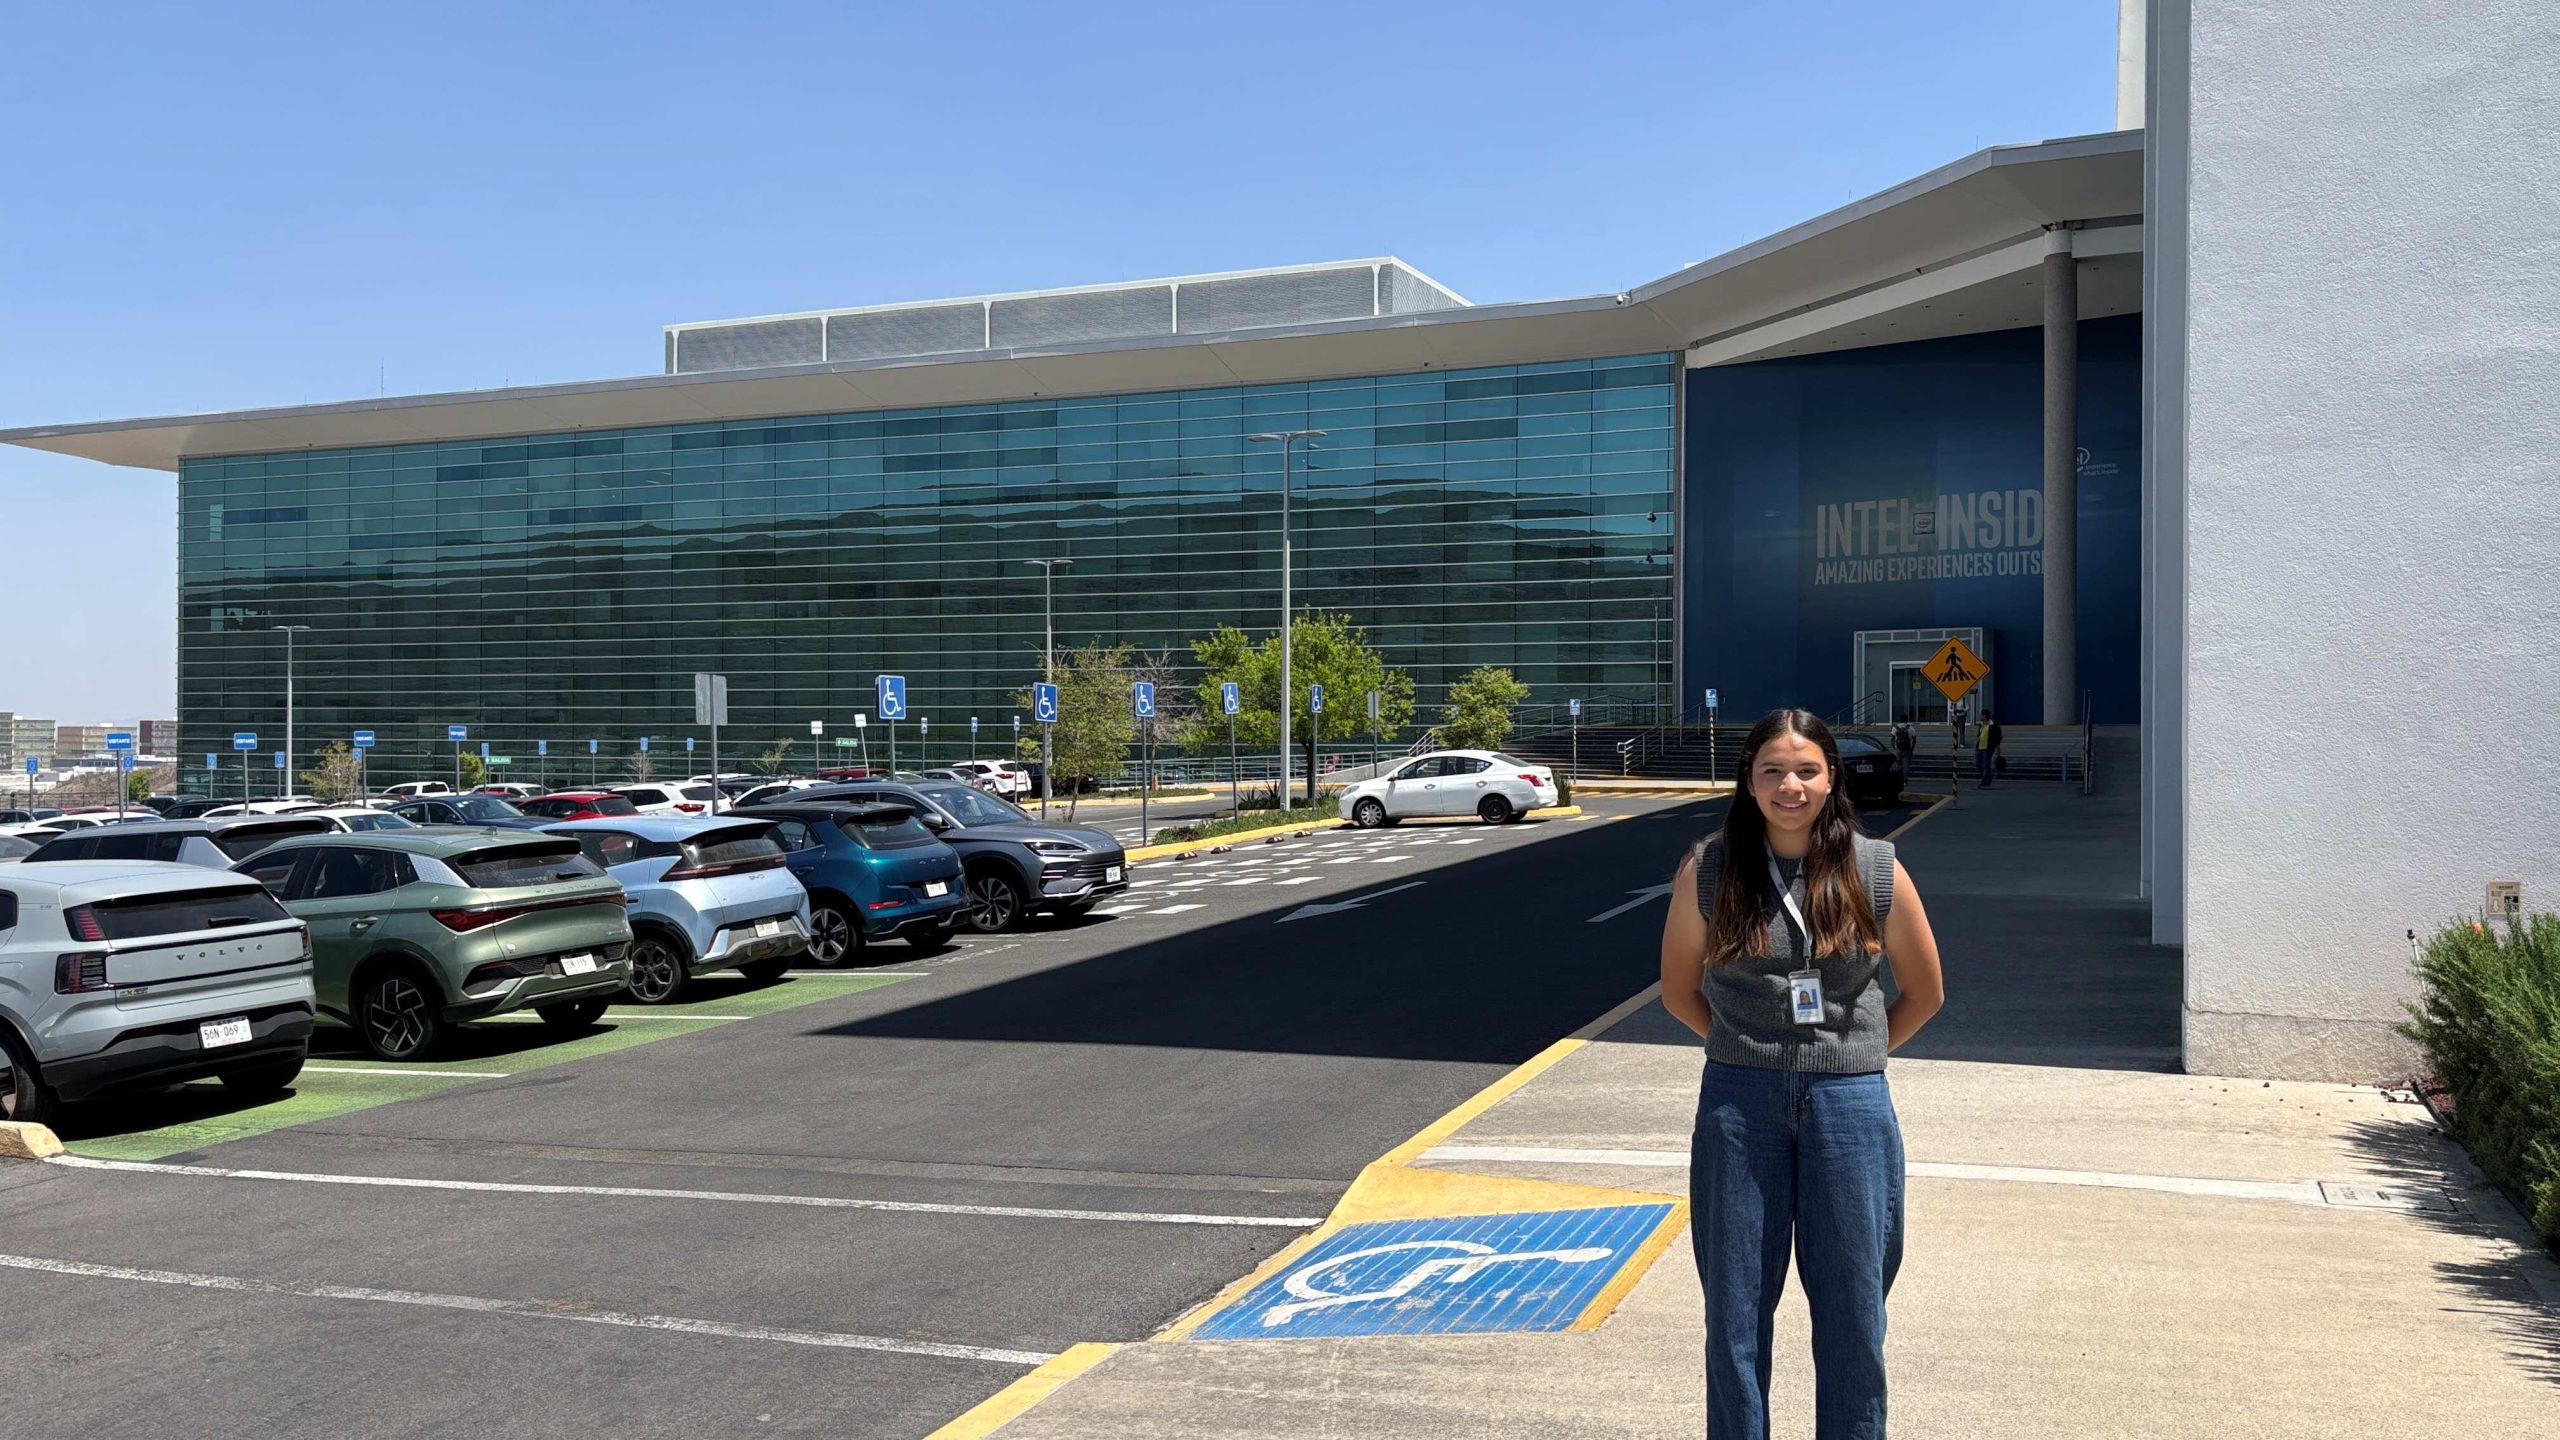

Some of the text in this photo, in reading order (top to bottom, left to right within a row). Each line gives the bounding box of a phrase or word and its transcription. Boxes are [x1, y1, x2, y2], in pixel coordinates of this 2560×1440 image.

[1816, 489, 2044, 558] INTEL INSID
[1815, 559, 1884, 585] AMAZING
[1887, 553, 1993, 582] EXPERIENCES
[176, 944, 263, 961] VOLVO
[203, 1023, 239, 1041] 56N-069
